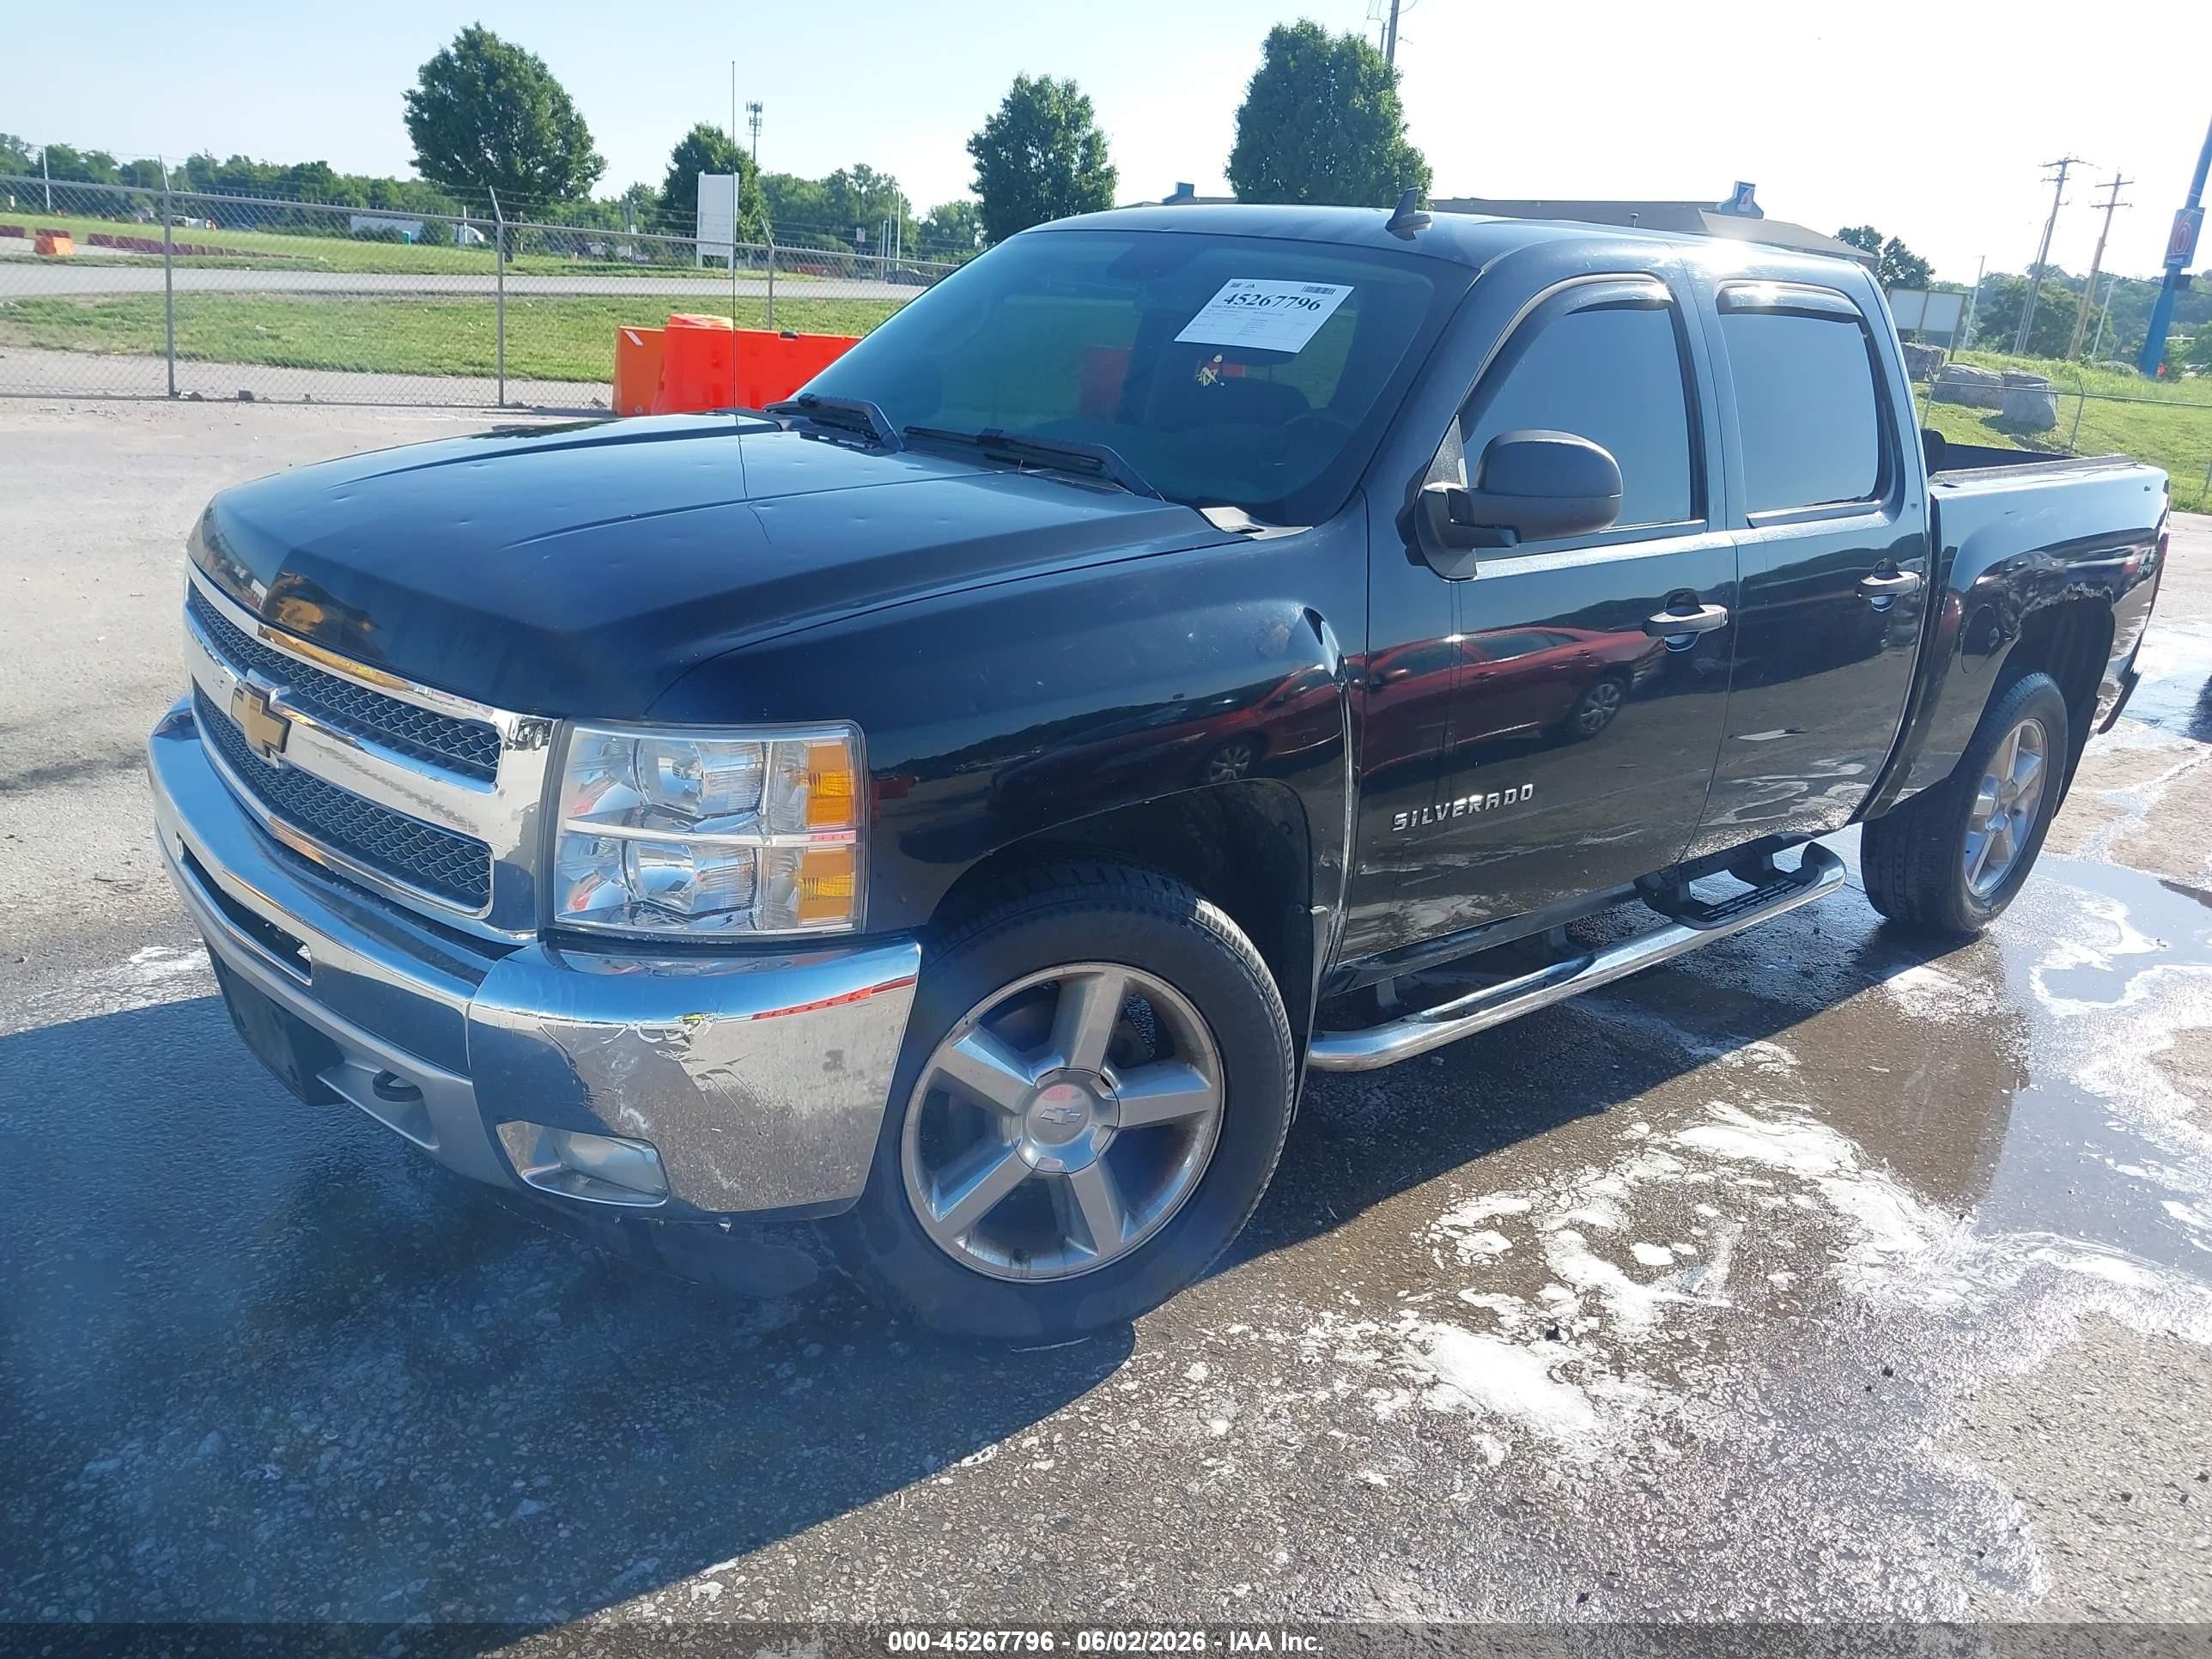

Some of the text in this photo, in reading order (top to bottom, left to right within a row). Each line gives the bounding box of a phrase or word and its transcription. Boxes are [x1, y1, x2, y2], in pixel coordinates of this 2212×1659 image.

[2171, 210, 2192, 255] 6
[1223, 293, 1322, 312] 45267796
[1392, 783, 1534, 831] SILVERADO
